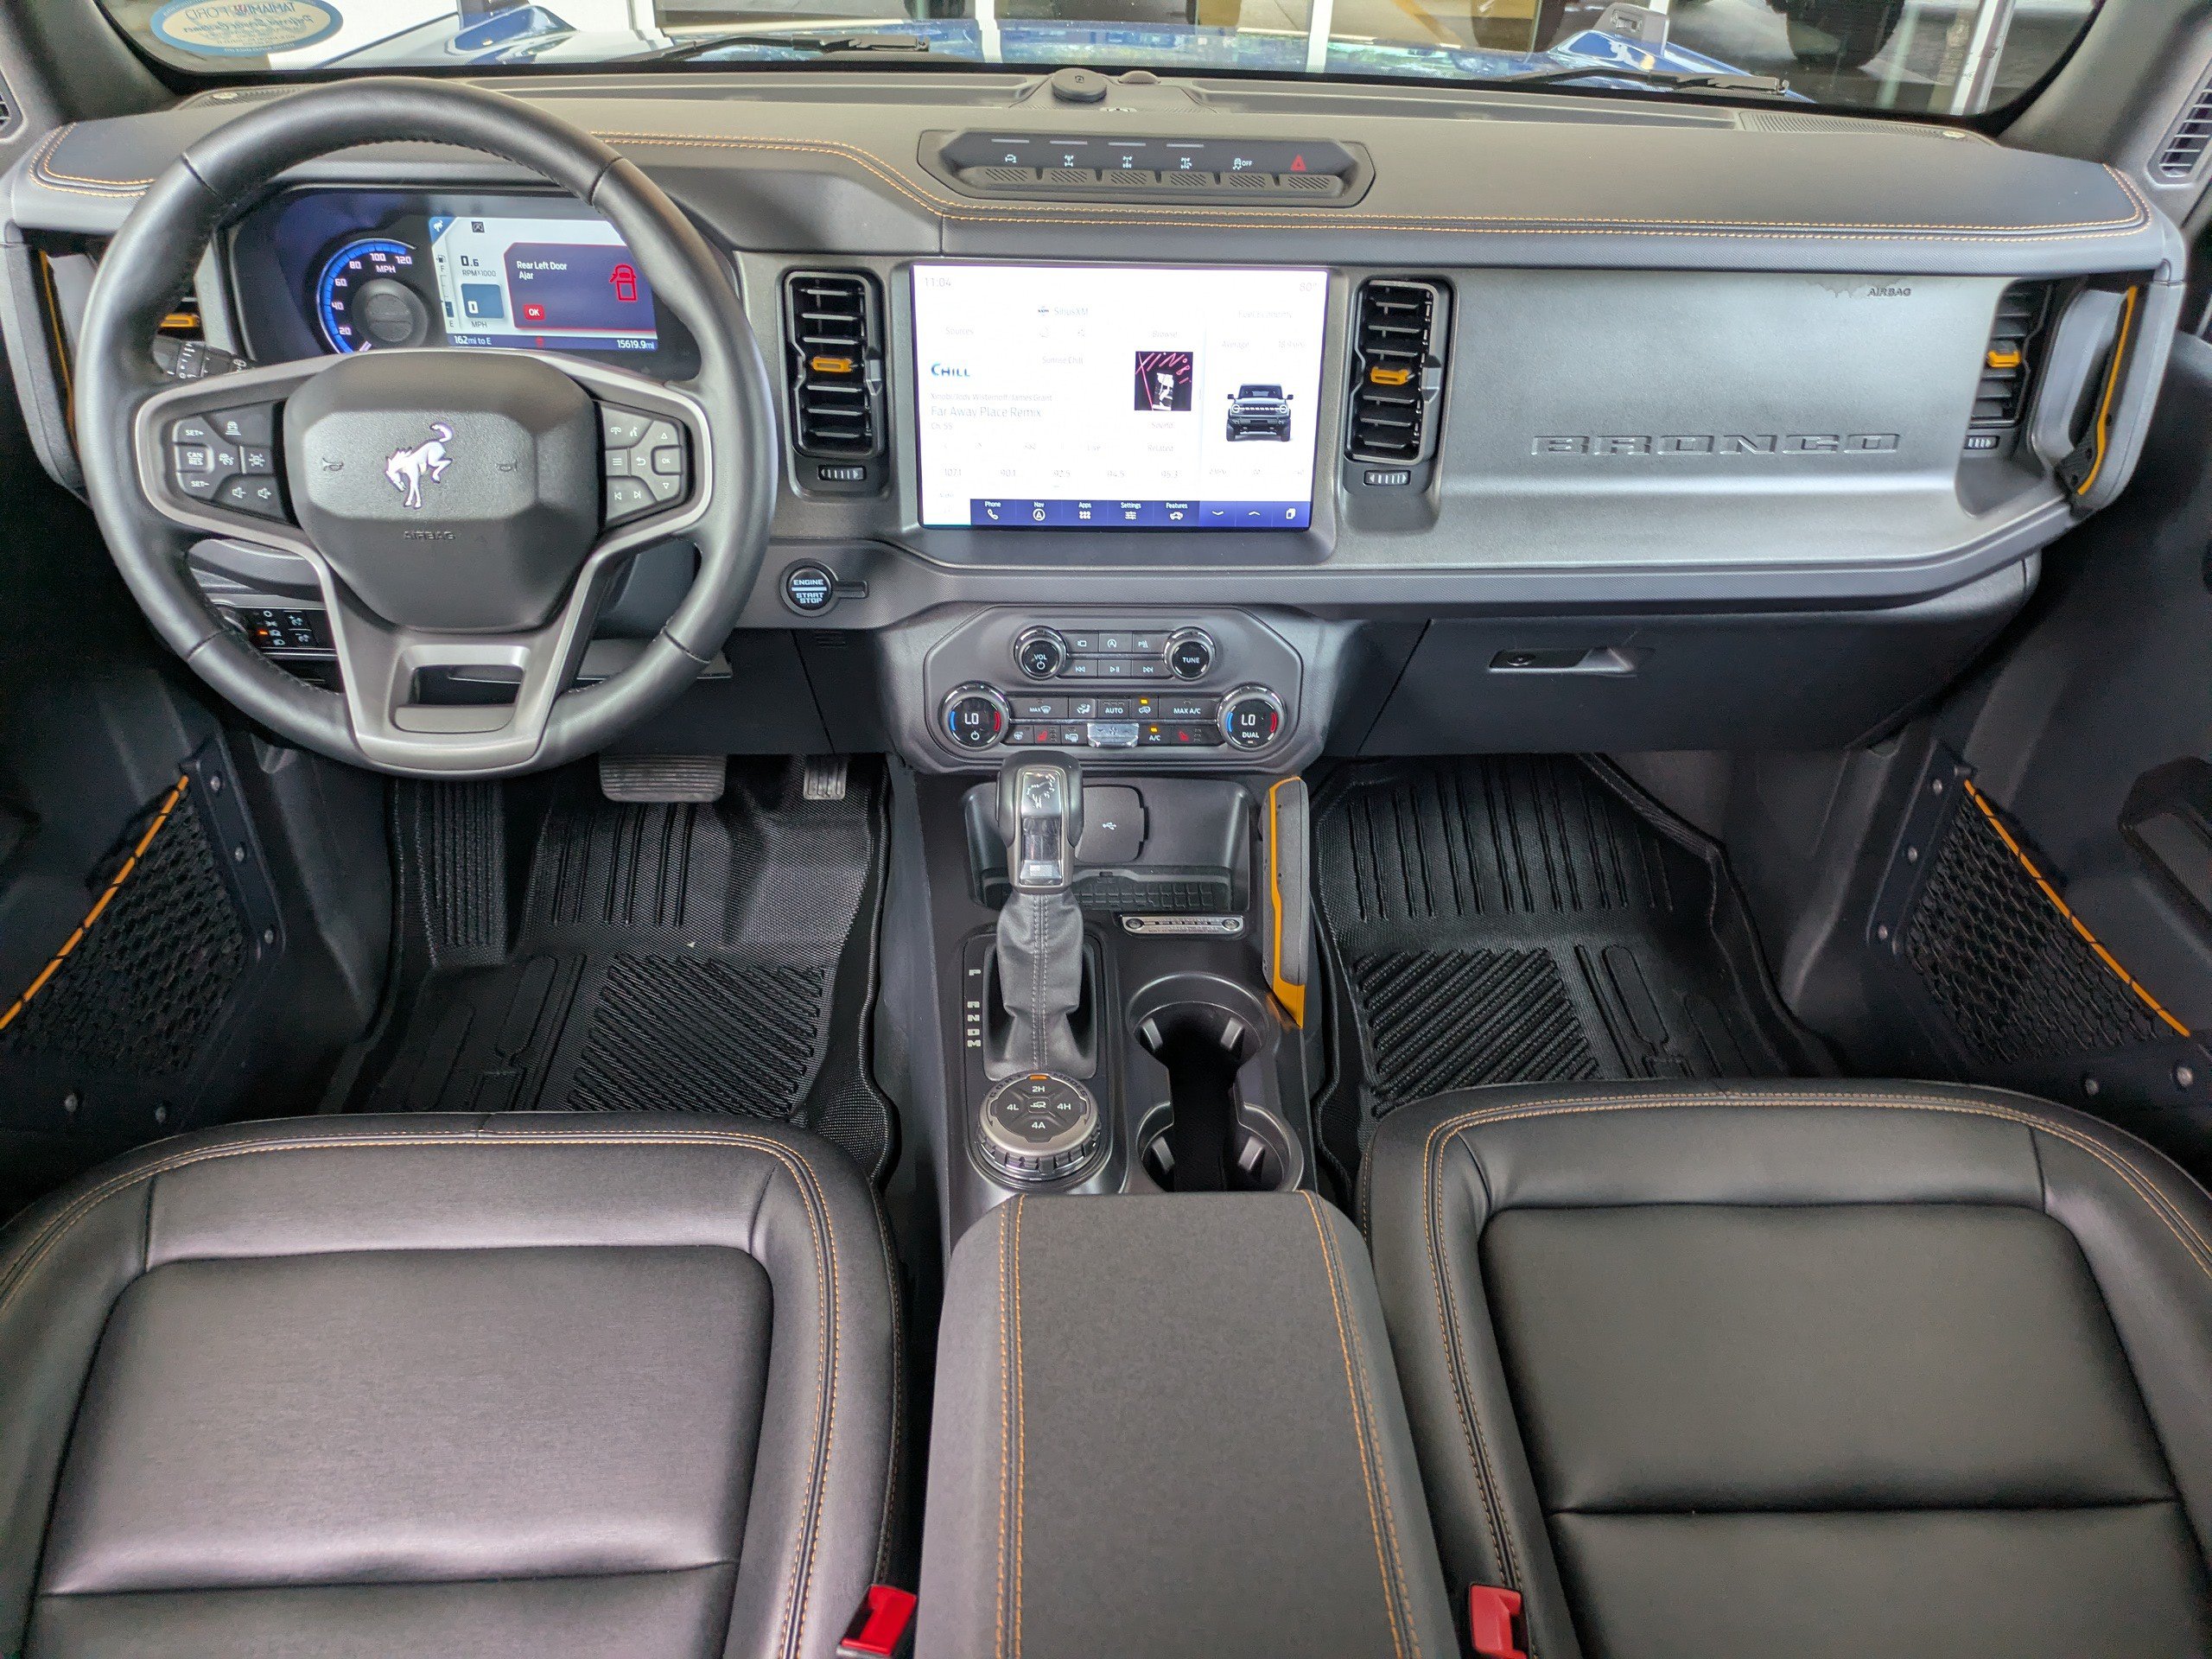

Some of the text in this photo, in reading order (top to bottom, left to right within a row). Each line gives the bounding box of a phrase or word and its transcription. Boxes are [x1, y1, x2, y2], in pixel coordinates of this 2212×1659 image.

[370, 252, 387, 262] 100
[395, 256, 413, 264] 120
[461, 255, 480, 267] 0.6
[349, 261, 362, 270] 80
[517, 261, 568, 270] Rear Left Door
[519, 271, 535, 281] Ajar
[334, 278, 347, 287] 60
[925, 276, 952, 288] 11:04
[1866, 287, 1911, 297] AIRBAG
[331, 302, 345, 310] 40
[528, 308, 541, 317] OK
[931, 405, 1042, 419] Far Away Place Remix
[1531, 433, 1900, 455] BRONCO
[964, 712, 980, 725] LO
[1241, 714, 1256, 727] LO
